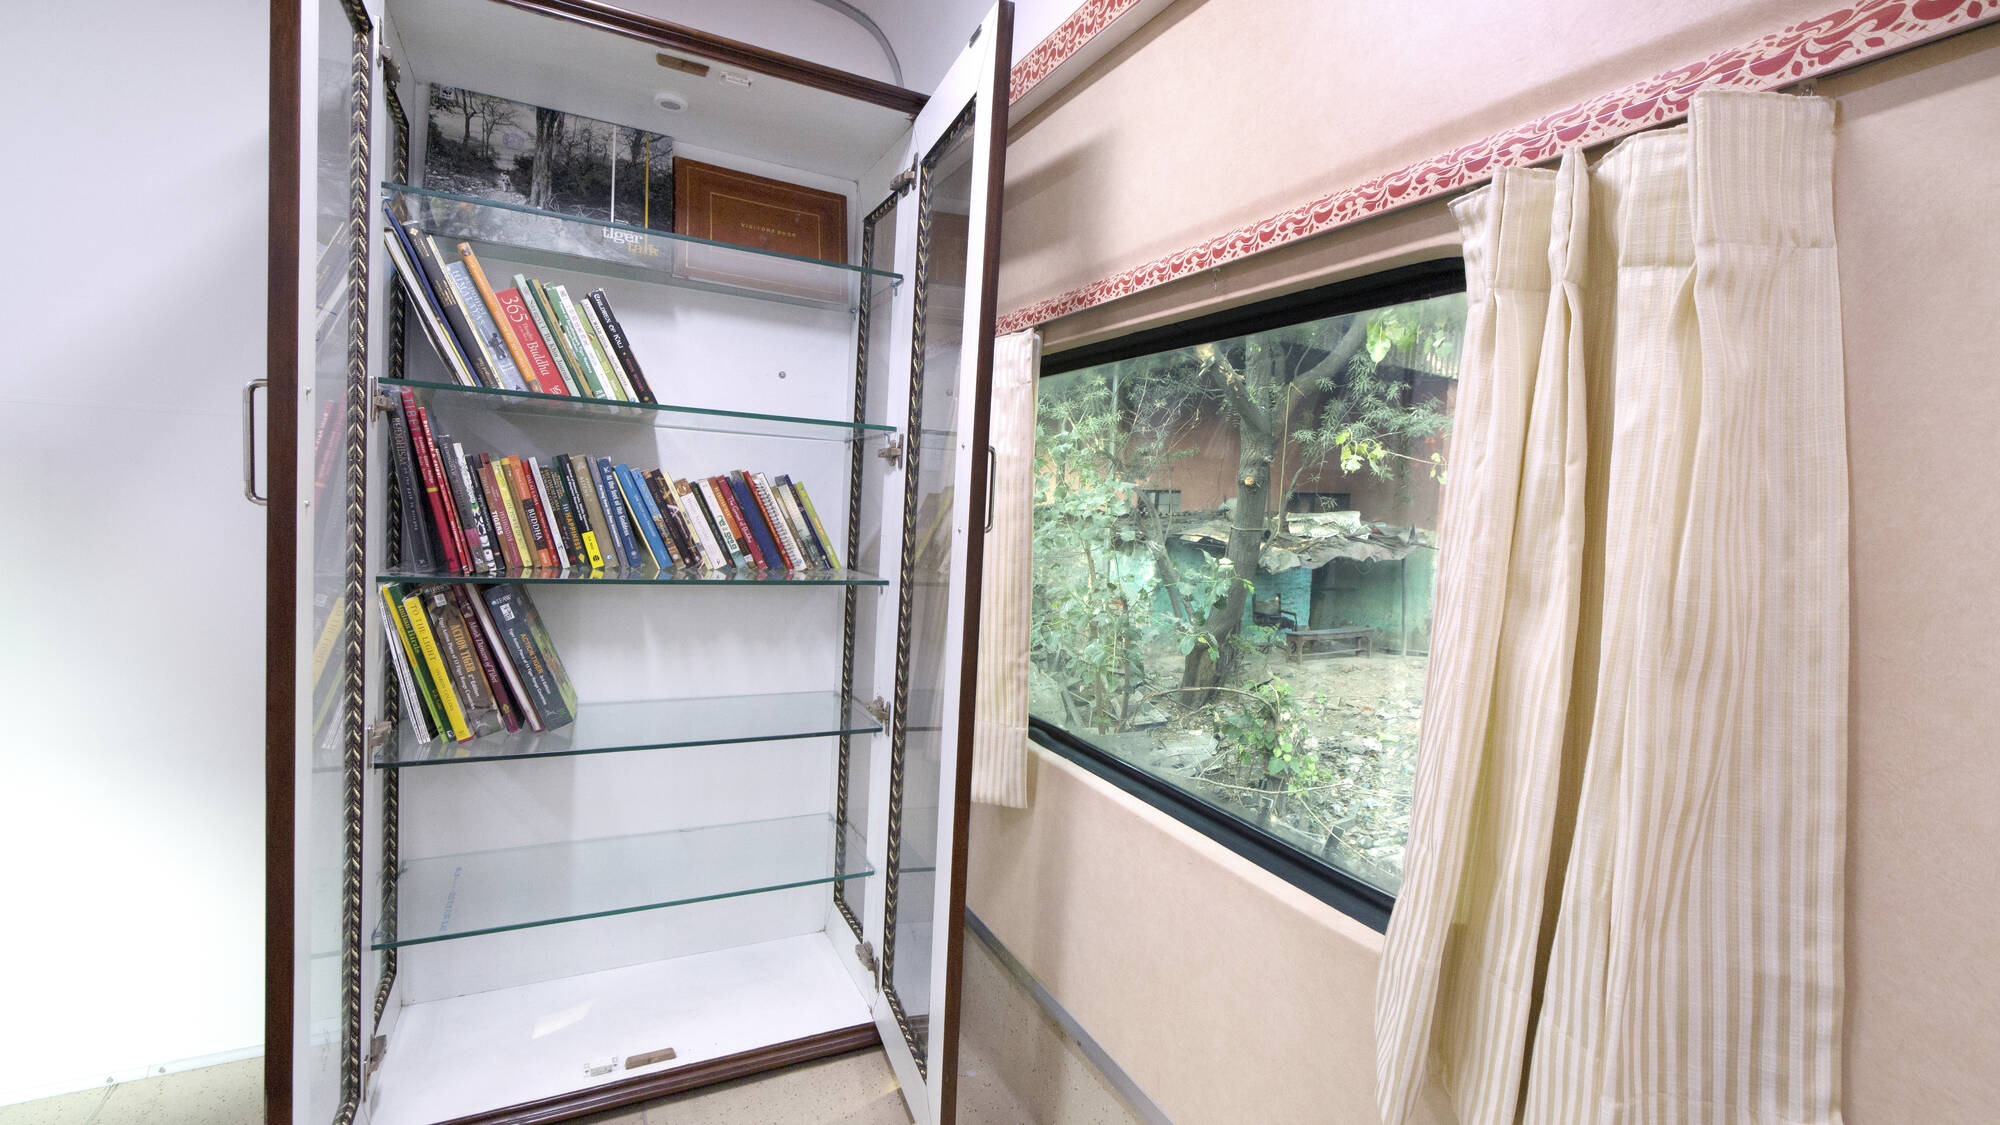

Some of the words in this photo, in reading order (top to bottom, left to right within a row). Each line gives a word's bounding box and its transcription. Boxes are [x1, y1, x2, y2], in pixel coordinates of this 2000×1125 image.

[601, 226, 643, 244] tiger
[500, 290, 529, 326] 365
[525, 338, 553, 377] Buddha
[556, 358, 571, 381] Journal
[402, 397, 421, 434] TIBET
[391, 416, 409, 465] BUDDHISM
[421, 419, 430, 436] Delhi
[426, 437, 434, 451] Agra
[433, 460, 442, 479] Jaipur
[607, 480, 615, 489] the
[618, 514, 630, 536] Goddess
[727, 495, 736, 505] The
[491, 510, 503, 535] TIGERS
[527, 507, 543, 541] BUDDHA
[564, 511, 582, 551] HAPPINESS
[409, 603, 420, 616] TO
[414, 617, 426, 634] THE
[468, 620, 481, 639] Monk
[407, 628, 422, 654] Birds
[421, 635, 437, 662] LIGHT
[474, 637, 489, 662] Dancers
[519, 631, 535, 657] ACTION
[530, 655, 543, 674] TIGER
[442, 628, 451, 642] Action
[458, 676, 468, 690] Range
[449, 622, 467, 650] ACTION
[459, 649, 475, 673] TIGER
[469, 679, 480, 697] Edition
[487, 667, 499, 684] Tibet
